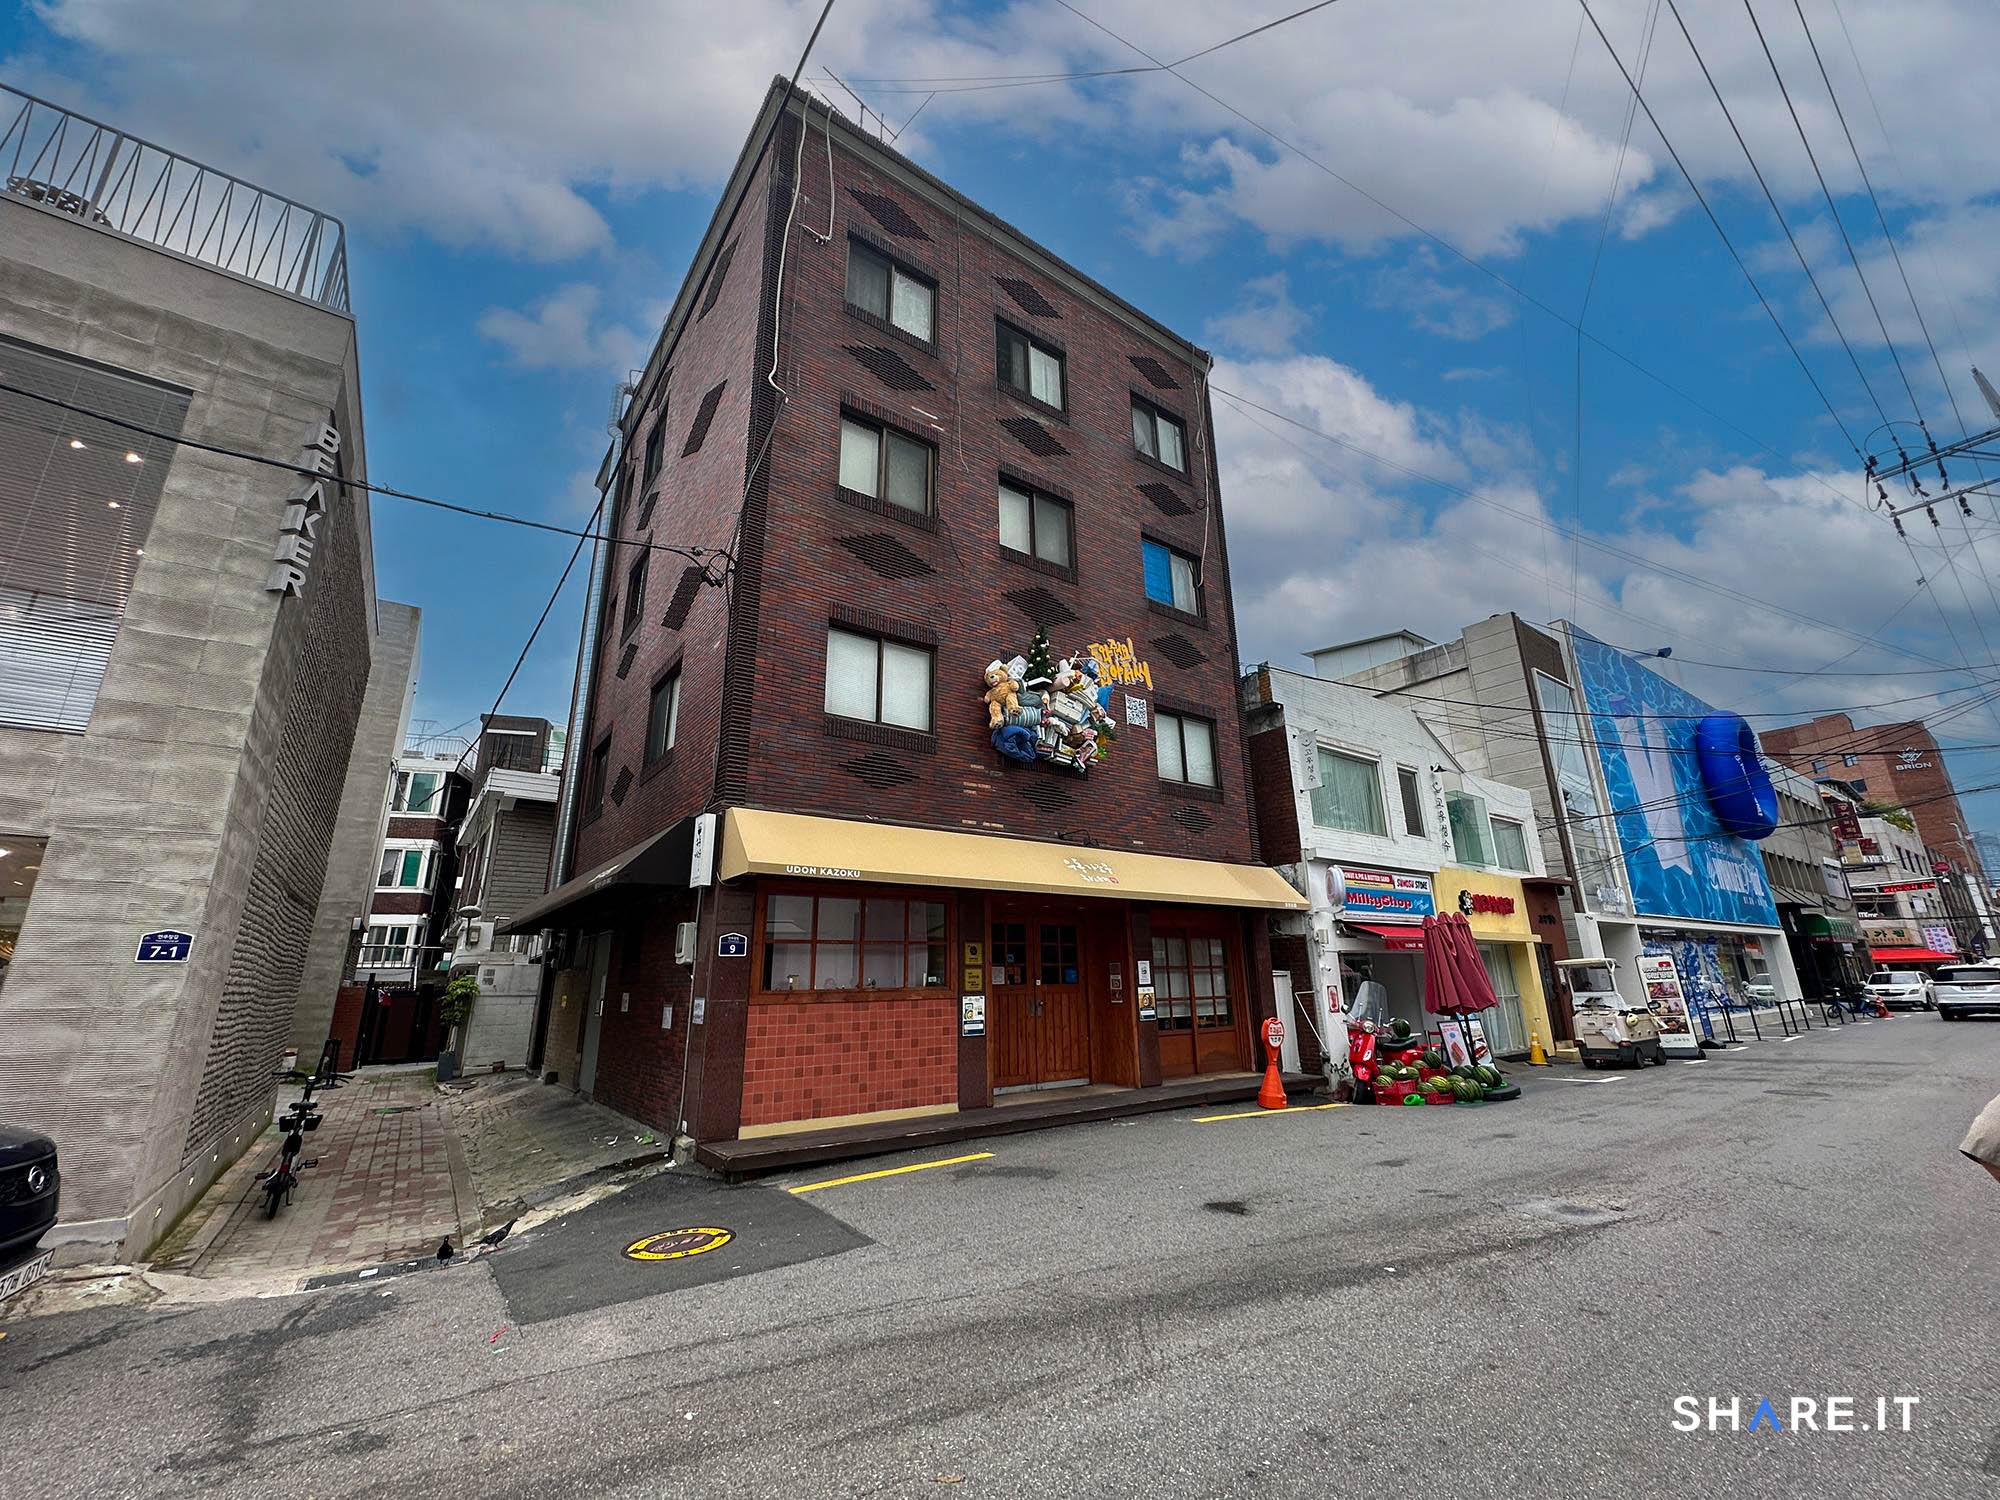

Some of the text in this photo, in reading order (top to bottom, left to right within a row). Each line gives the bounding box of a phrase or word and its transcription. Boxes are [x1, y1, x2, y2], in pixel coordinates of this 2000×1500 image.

[276, 422, 341, 599] BEAKER
[1895, 761, 1933, 771] BRION
[786, 865, 861, 878] UDON KAZOKU
[1345, 892, 1413, 911] MilkyShop
[149, 945, 178, 958] 7-1
[729, 944, 736, 954] 9
